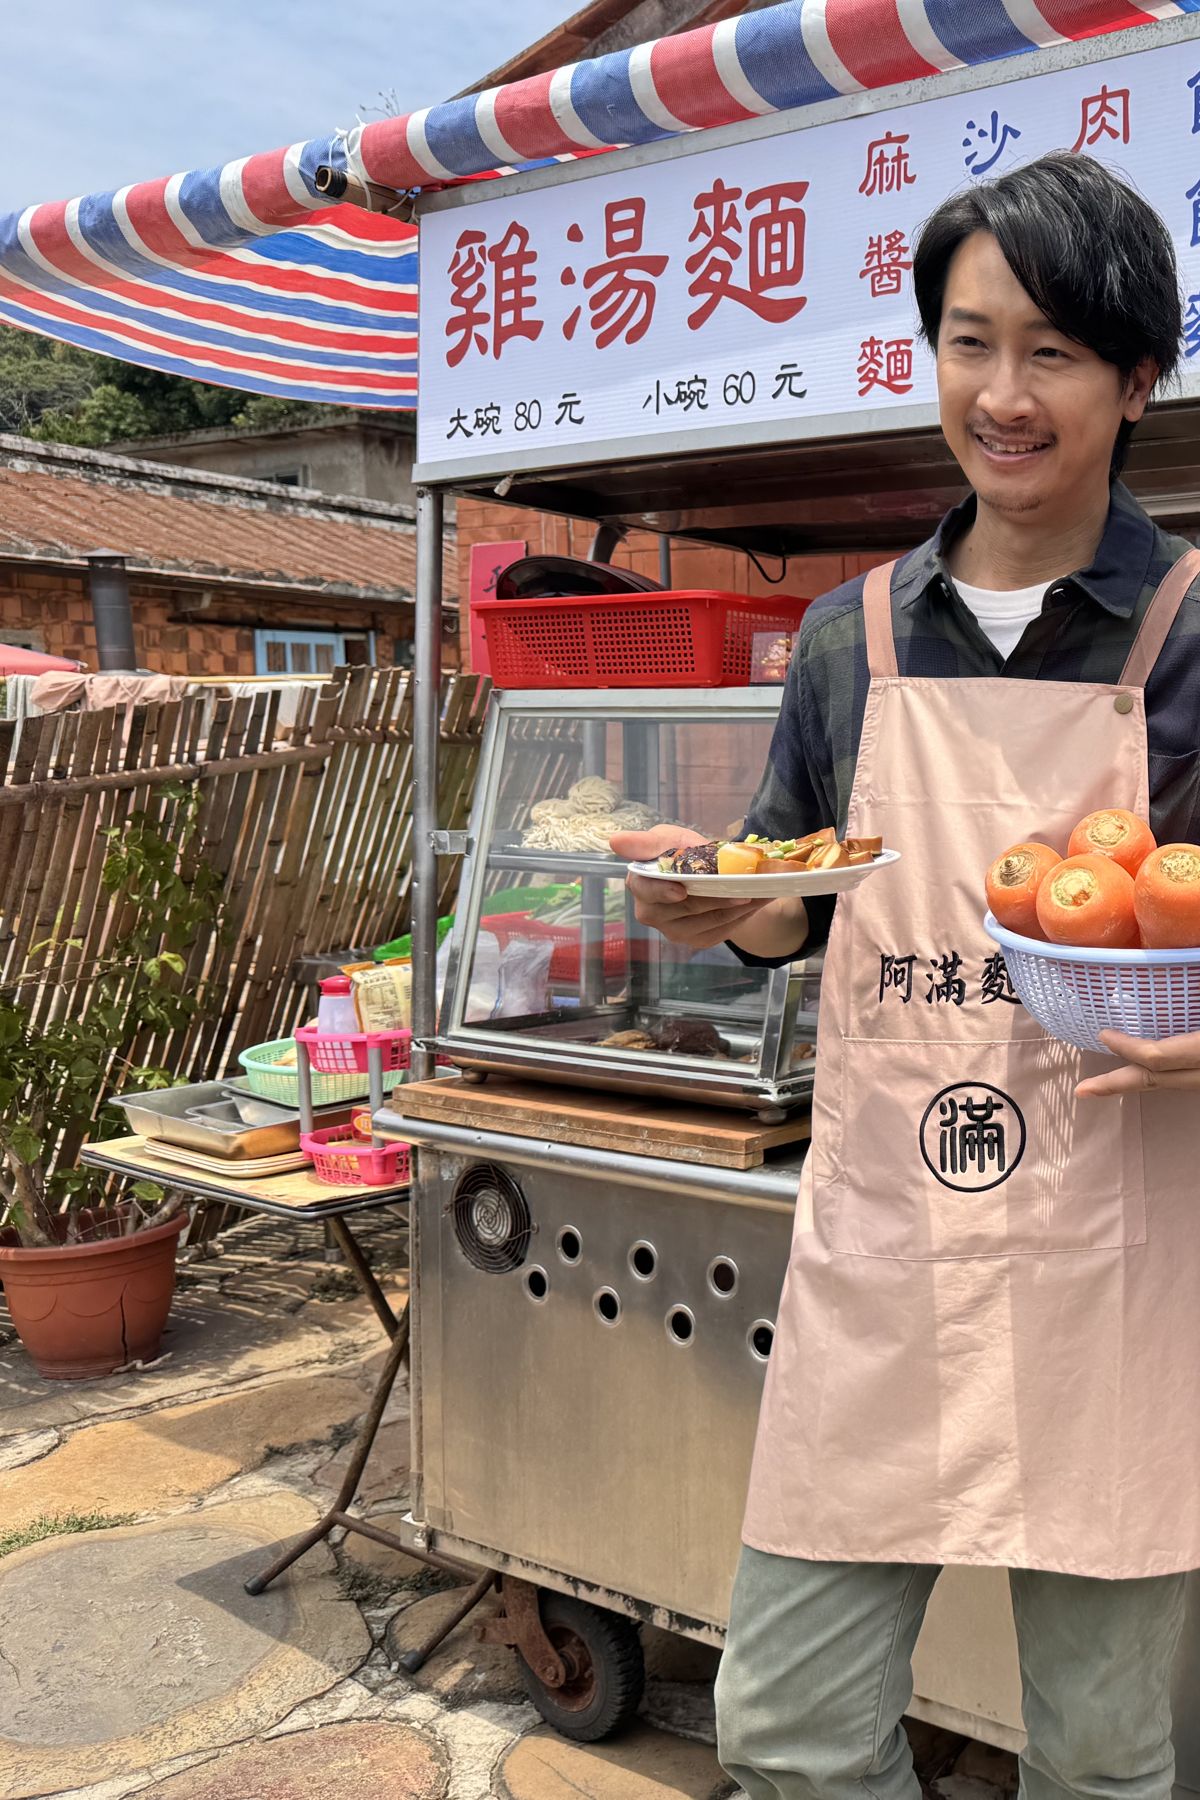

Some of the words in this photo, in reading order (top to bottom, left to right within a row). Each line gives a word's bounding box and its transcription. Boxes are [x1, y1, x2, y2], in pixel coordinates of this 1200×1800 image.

[446, 178, 810, 368] 雞湯麵
[858, 131, 917, 397] 麻醬麵
[446, 402, 502, 439] 大碗
[514, 399, 542, 431] 80
[554, 393, 585, 425] 元
[642, 374, 709, 415] 小碗
[723, 371, 756, 406] 60
[771, 363, 808, 399] 元
[939, 1096, 1005, 1175] 滿
